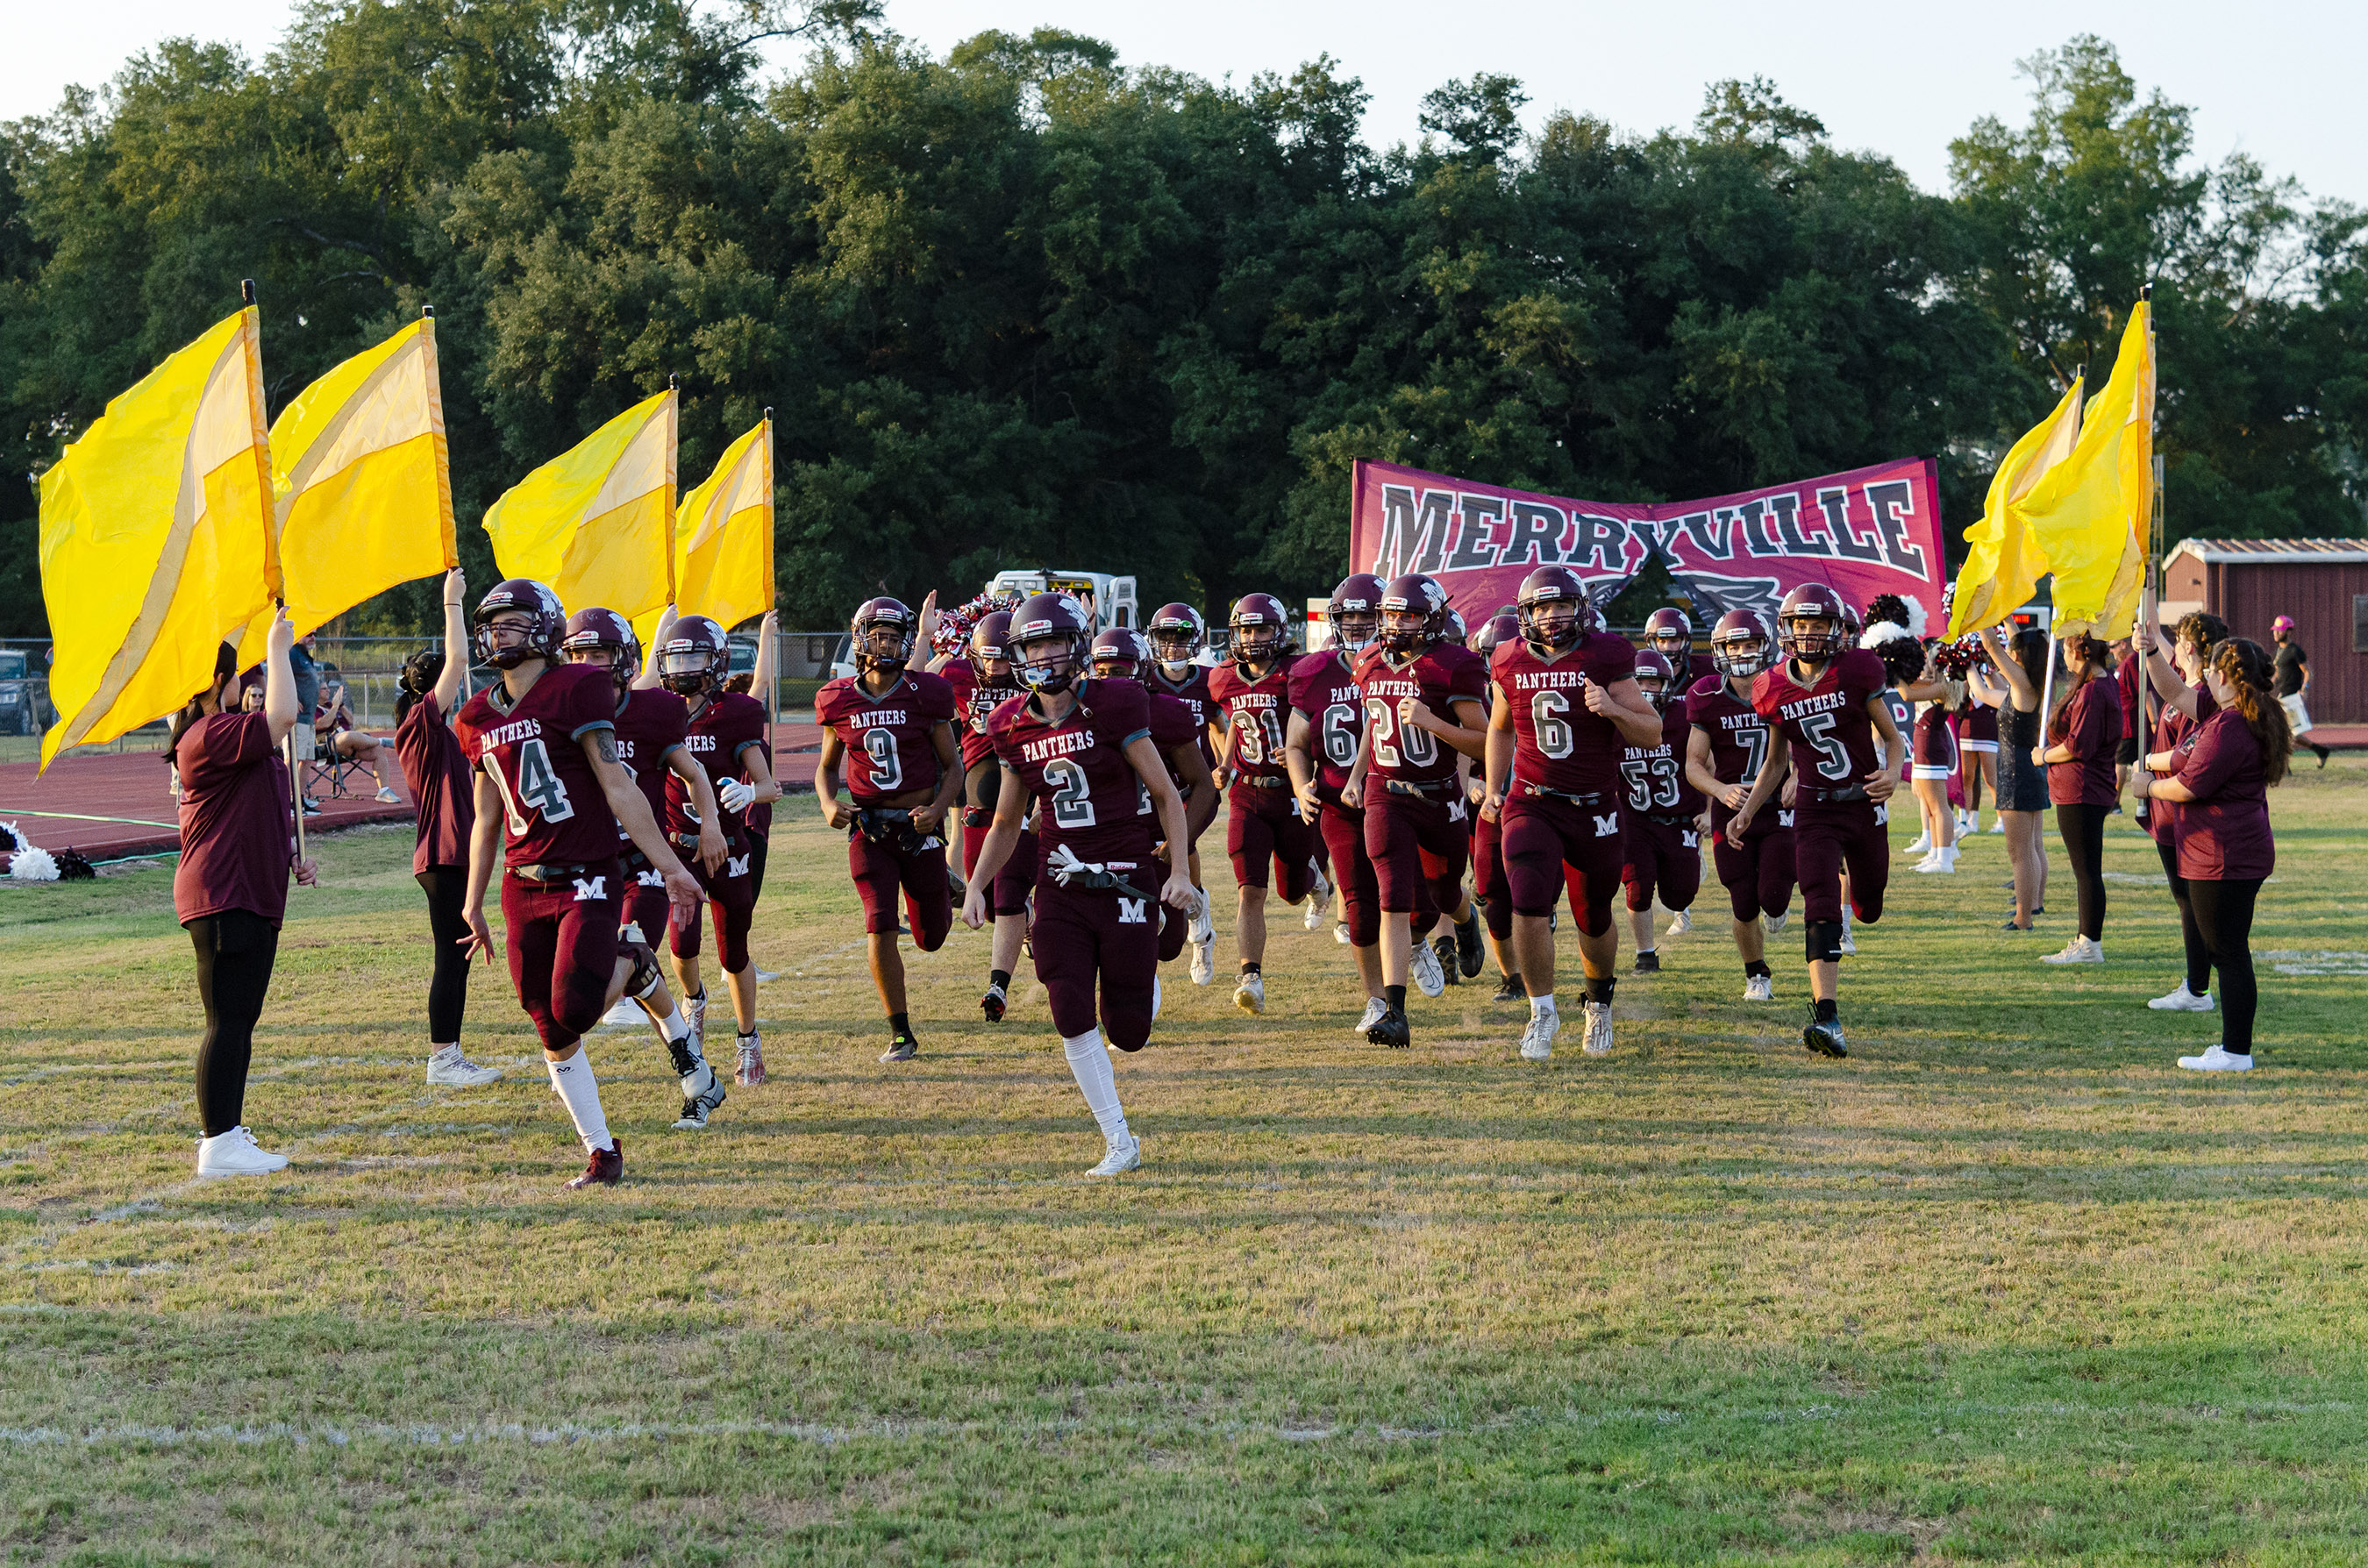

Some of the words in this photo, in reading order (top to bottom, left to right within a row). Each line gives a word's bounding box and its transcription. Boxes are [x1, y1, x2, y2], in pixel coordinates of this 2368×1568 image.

[1373, 478, 1930, 582] MERRYVILLE
[1366, 681, 1421, 697] PANTHERS
[1515, 671, 1586, 690] PANTHERS
[1230, 693, 1277, 710] PANTHERS
[1780, 690, 1846, 721] PANTHERS
[480, 717, 542, 752] PANTHERS
[849, 709, 906, 729] PANTHERS
[1323, 703, 1369, 767] 6
[1366, 697, 1438, 768] 20
[1531, 689, 1573, 759] 6
[1720, 712, 1769, 730] PANTH
[1022, 730, 1095, 763] PANTHERS
[1230, 709, 1284, 766] 31
[1799, 711, 1852, 780] 5
[863, 727, 903, 790] 9
[1735, 728, 1767, 784] 7
[483, 738, 575, 836] 14
[1043, 757, 1096, 829] 2
[1620, 758, 1680, 812] 53
[1447, 796, 1466, 823] M
[1593, 811, 1619, 837] M
[1681, 830, 1698, 848] M
[637, 868, 666, 887] M
[727, 852, 750, 877] M
[572, 876, 608, 902] M
[1117, 897, 1147, 924] M
